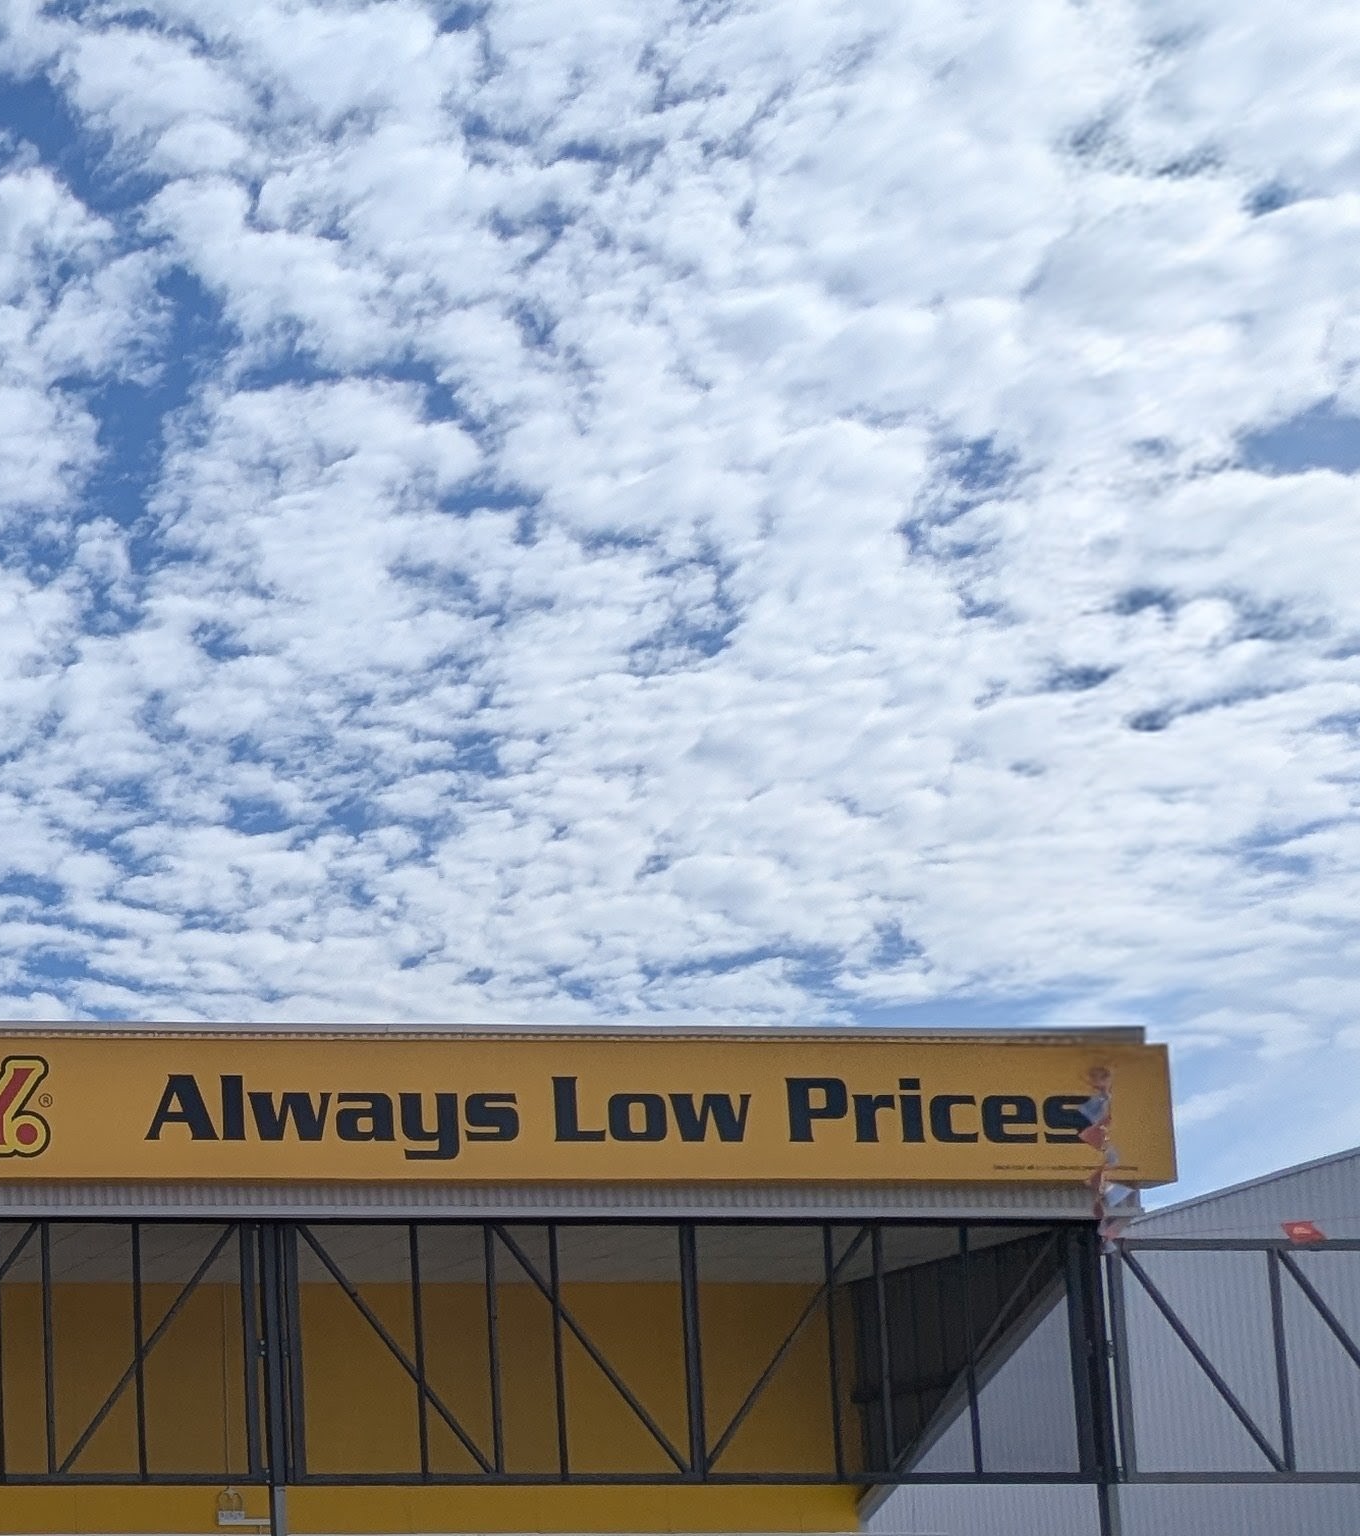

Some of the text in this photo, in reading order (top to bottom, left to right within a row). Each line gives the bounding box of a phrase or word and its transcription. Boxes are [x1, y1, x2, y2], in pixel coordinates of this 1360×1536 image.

[144, 1073, 1095, 1162] Always Low Prices
